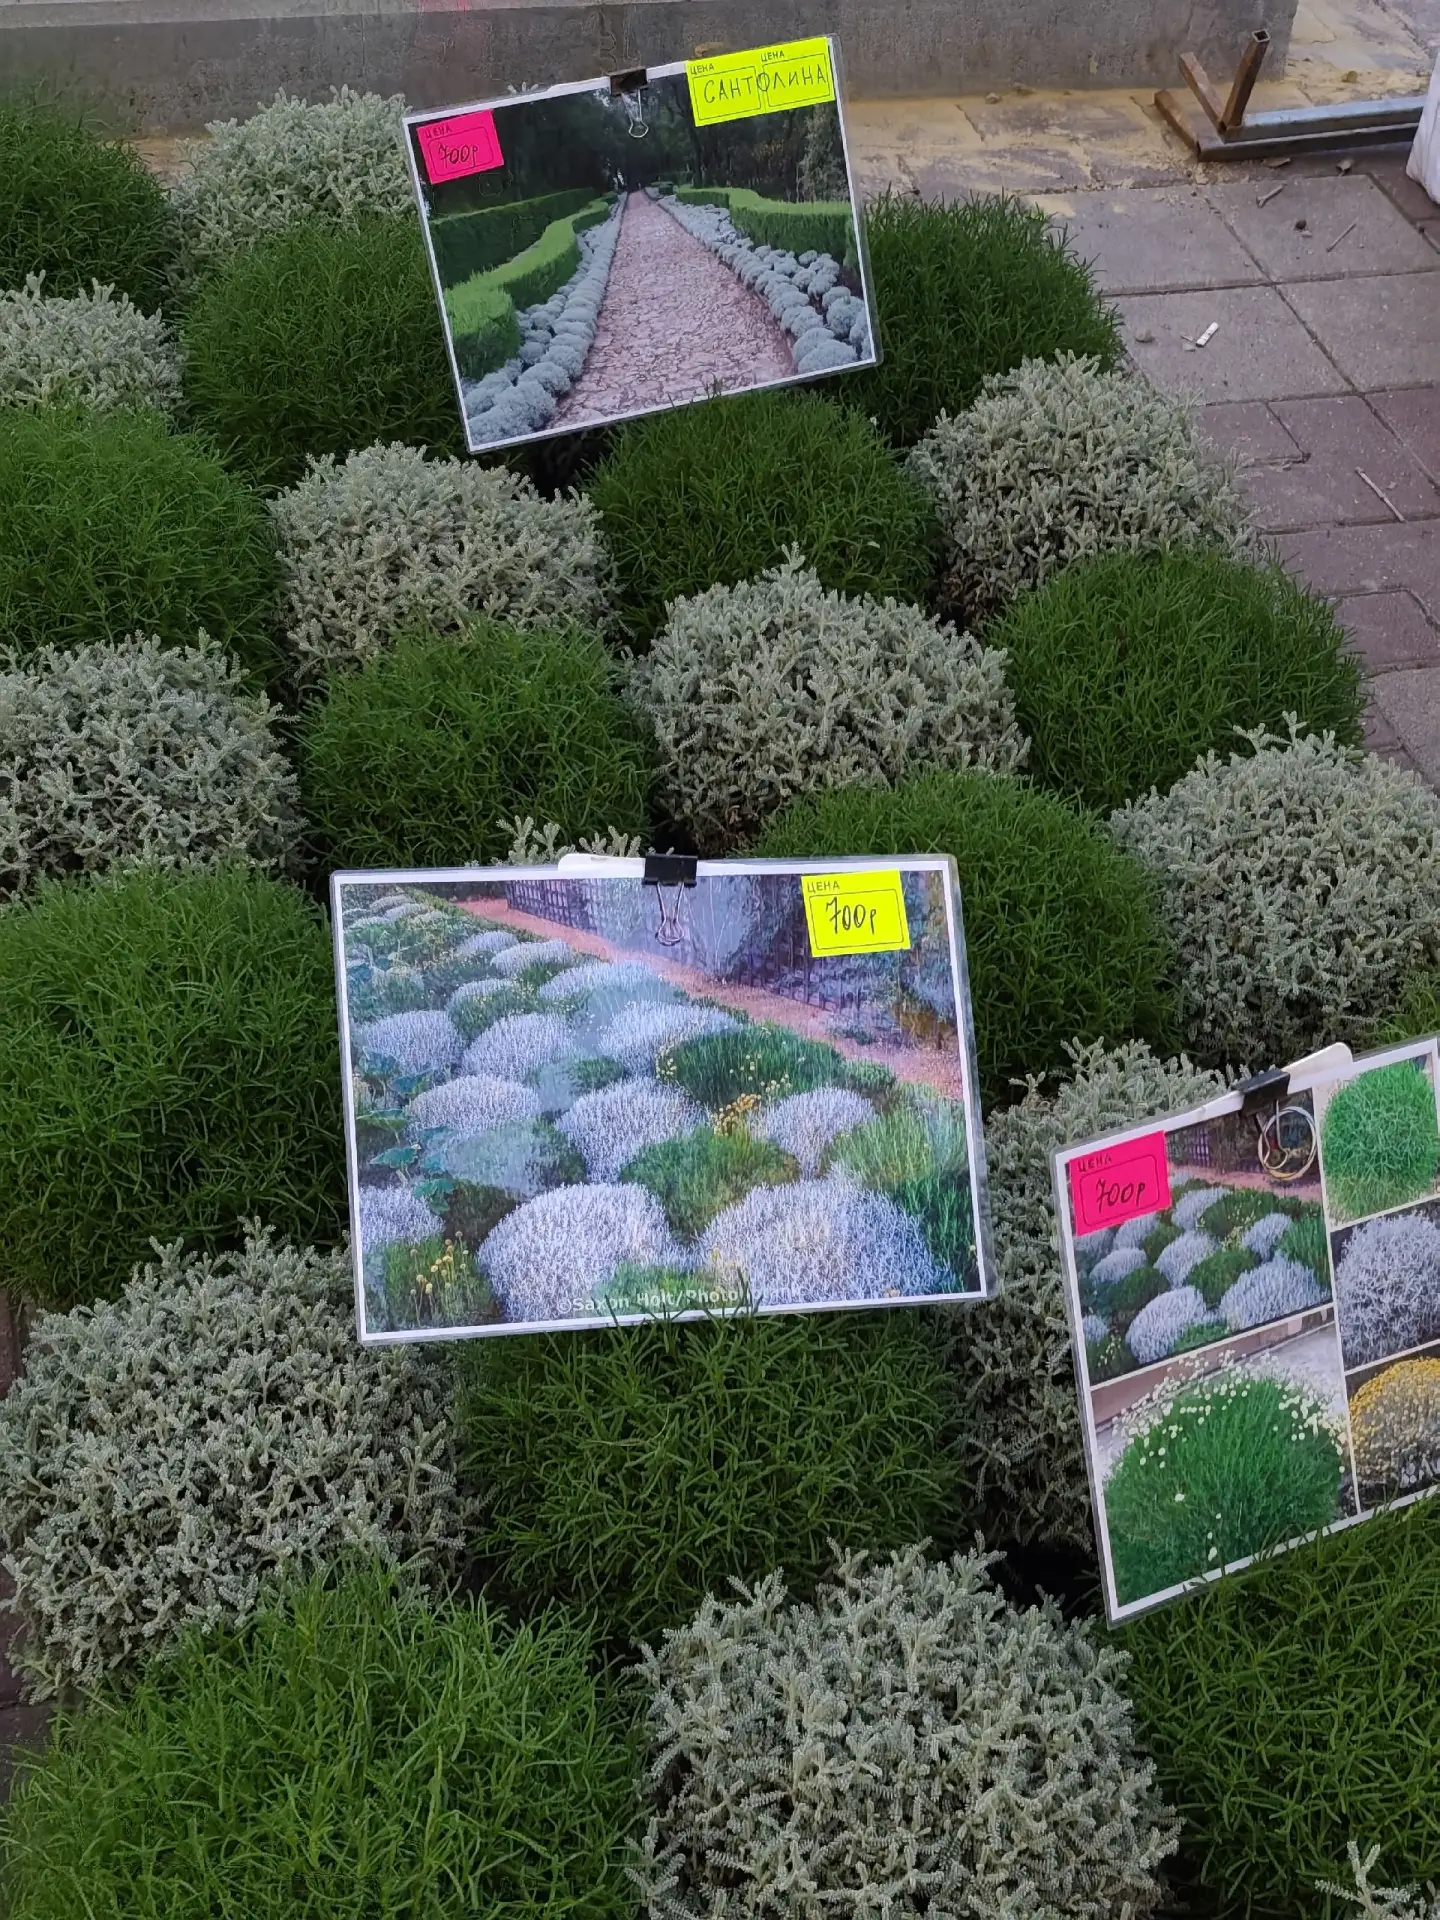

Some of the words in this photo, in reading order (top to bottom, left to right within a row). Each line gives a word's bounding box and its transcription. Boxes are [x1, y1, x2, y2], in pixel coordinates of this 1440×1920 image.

[760, 50, 785, 62] ЦЕНА
[690, 63, 715, 75] ЦЕНА
[704, 63, 826, 104] САНТОЛИНА
[425, 123, 452, 139] ЦЕНА
[807, 880, 840, 893] ЦЕНА
[826, 896, 876, 935] 700р
[1078, 1153, 1112, 1172] ЦЕНА
